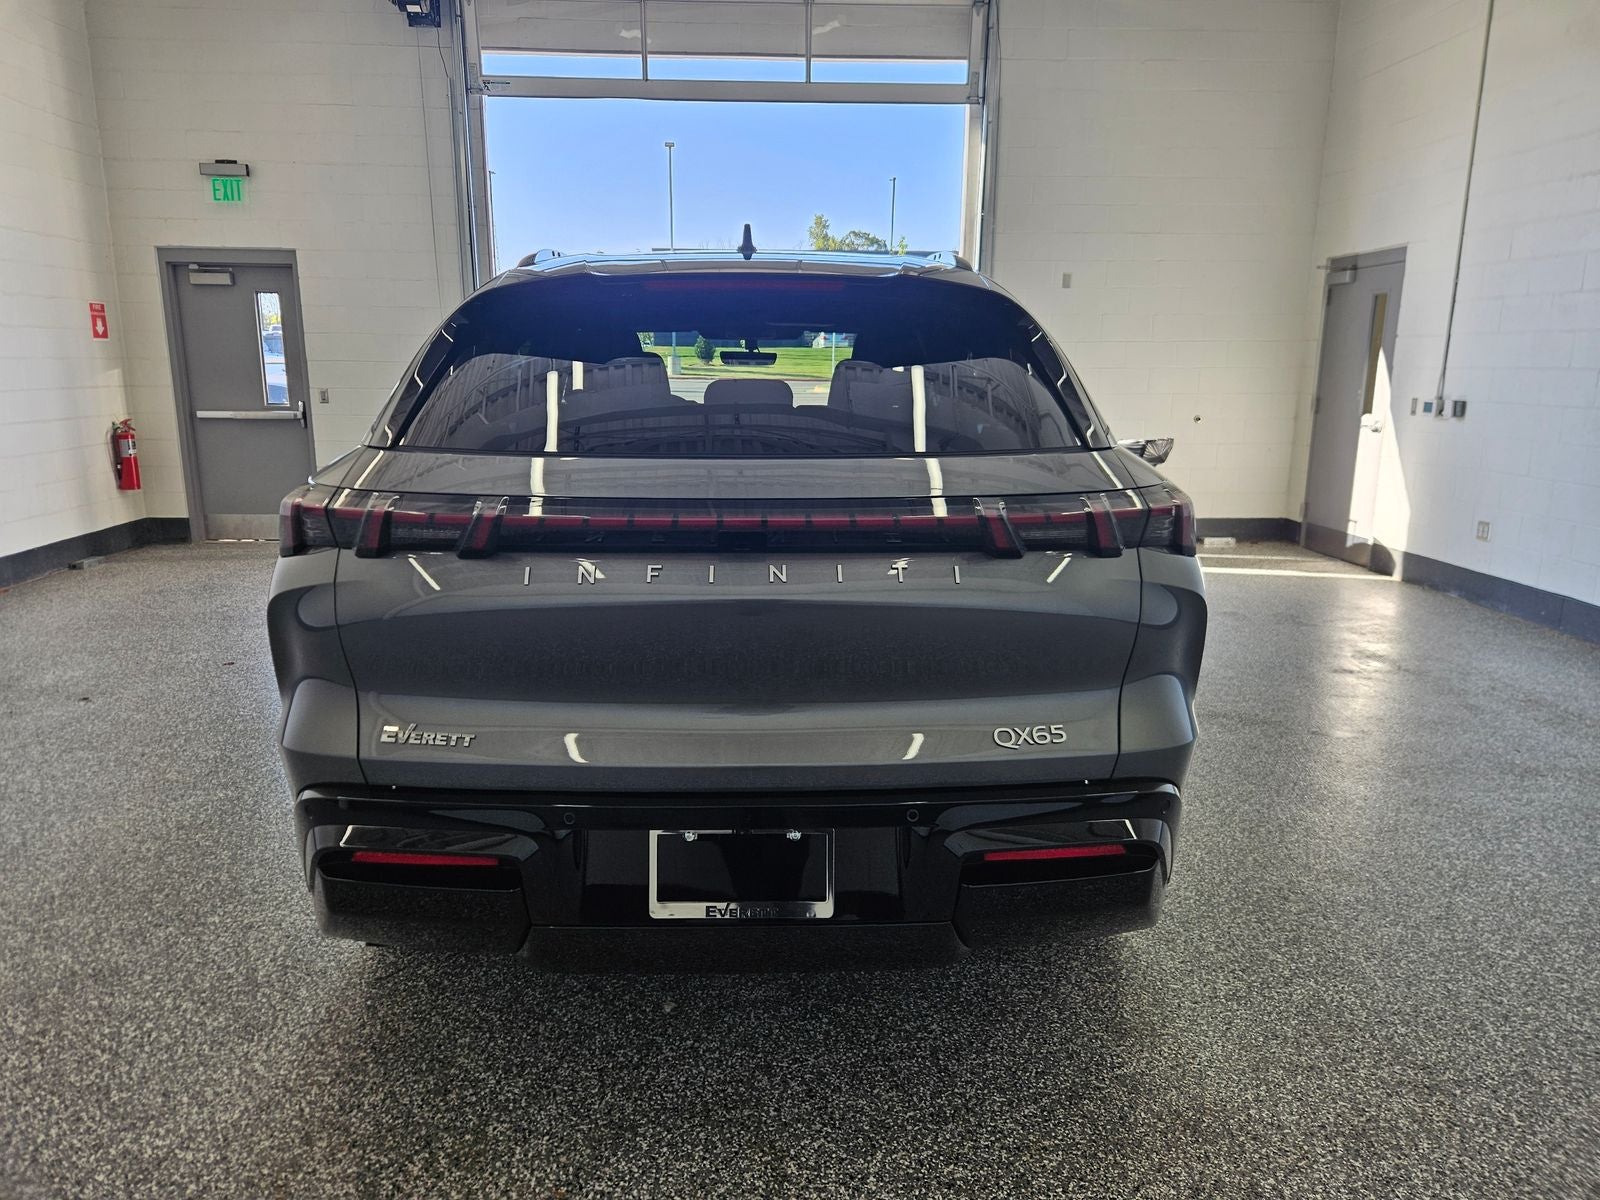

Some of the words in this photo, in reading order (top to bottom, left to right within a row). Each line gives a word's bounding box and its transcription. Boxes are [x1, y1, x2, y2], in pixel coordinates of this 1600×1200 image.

[212, 178, 242, 201] EXIT
[523, 564, 961, 585] INFINITI
[380, 723, 475, 747] EVERETT
[993, 724, 1067, 749] QX65
